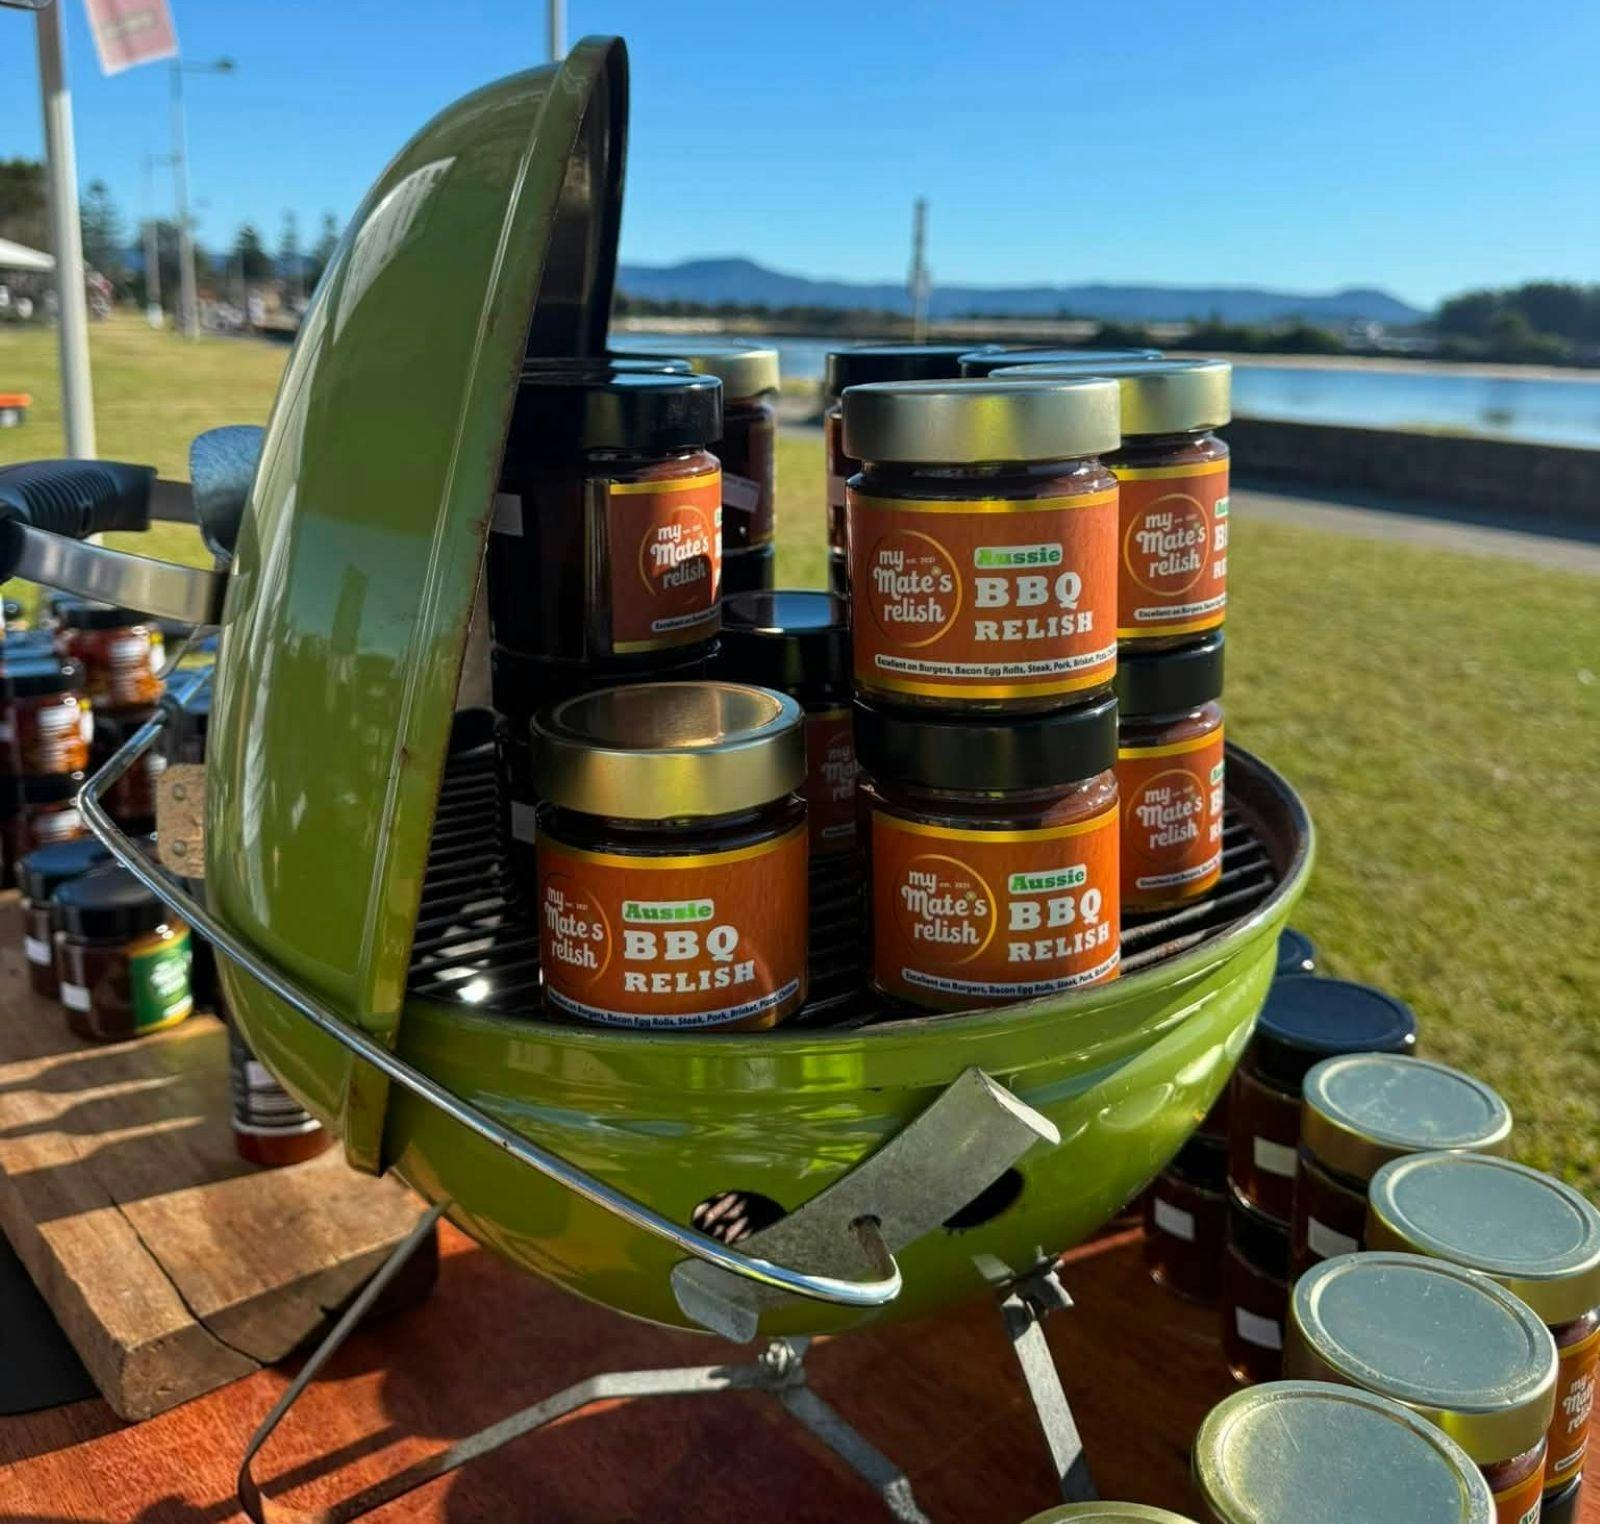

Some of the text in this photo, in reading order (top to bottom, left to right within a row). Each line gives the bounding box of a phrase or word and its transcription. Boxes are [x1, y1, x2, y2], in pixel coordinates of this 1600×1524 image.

[658, 524, 682, 542] my
[1145, 512, 1172, 531] my
[651, 535, 709, 567] Mate's
[1136, 525, 1206, 557] Mate's
[879, 550, 904, 572] my
[978, 547, 1061, 566] Aussie
[1149, 550, 1201, 578] relish
[663, 558, 706, 588] relish
[873, 566, 953, 600] Mate's
[974, 571, 1082, 609] BBQ
[883, 597, 946, 623] relish
[974, 610, 1094, 641] RELISH
[955, 665, 983, 675] Bacon
[1145, 786, 1171, 805] my
[1136, 796, 1203, 829] Mate's
[1150, 822, 1199, 849] relish
[908, 870, 937, 894] my
[1011, 869, 1085, 891] Aussie
[547, 886, 564, 912] my
[624, 902, 713, 921] Aussie
[901, 885, 988, 920] Mate's
[1008, 888, 1102, 931] BBQ
[623, 925, 739, 962] BBQ
[914, 921, 980, 945] relish
[1007, 921, 1110, 962] RELISH
[552, 938, 599, 969] relish
[624, 960, 755, 994] RELISH
